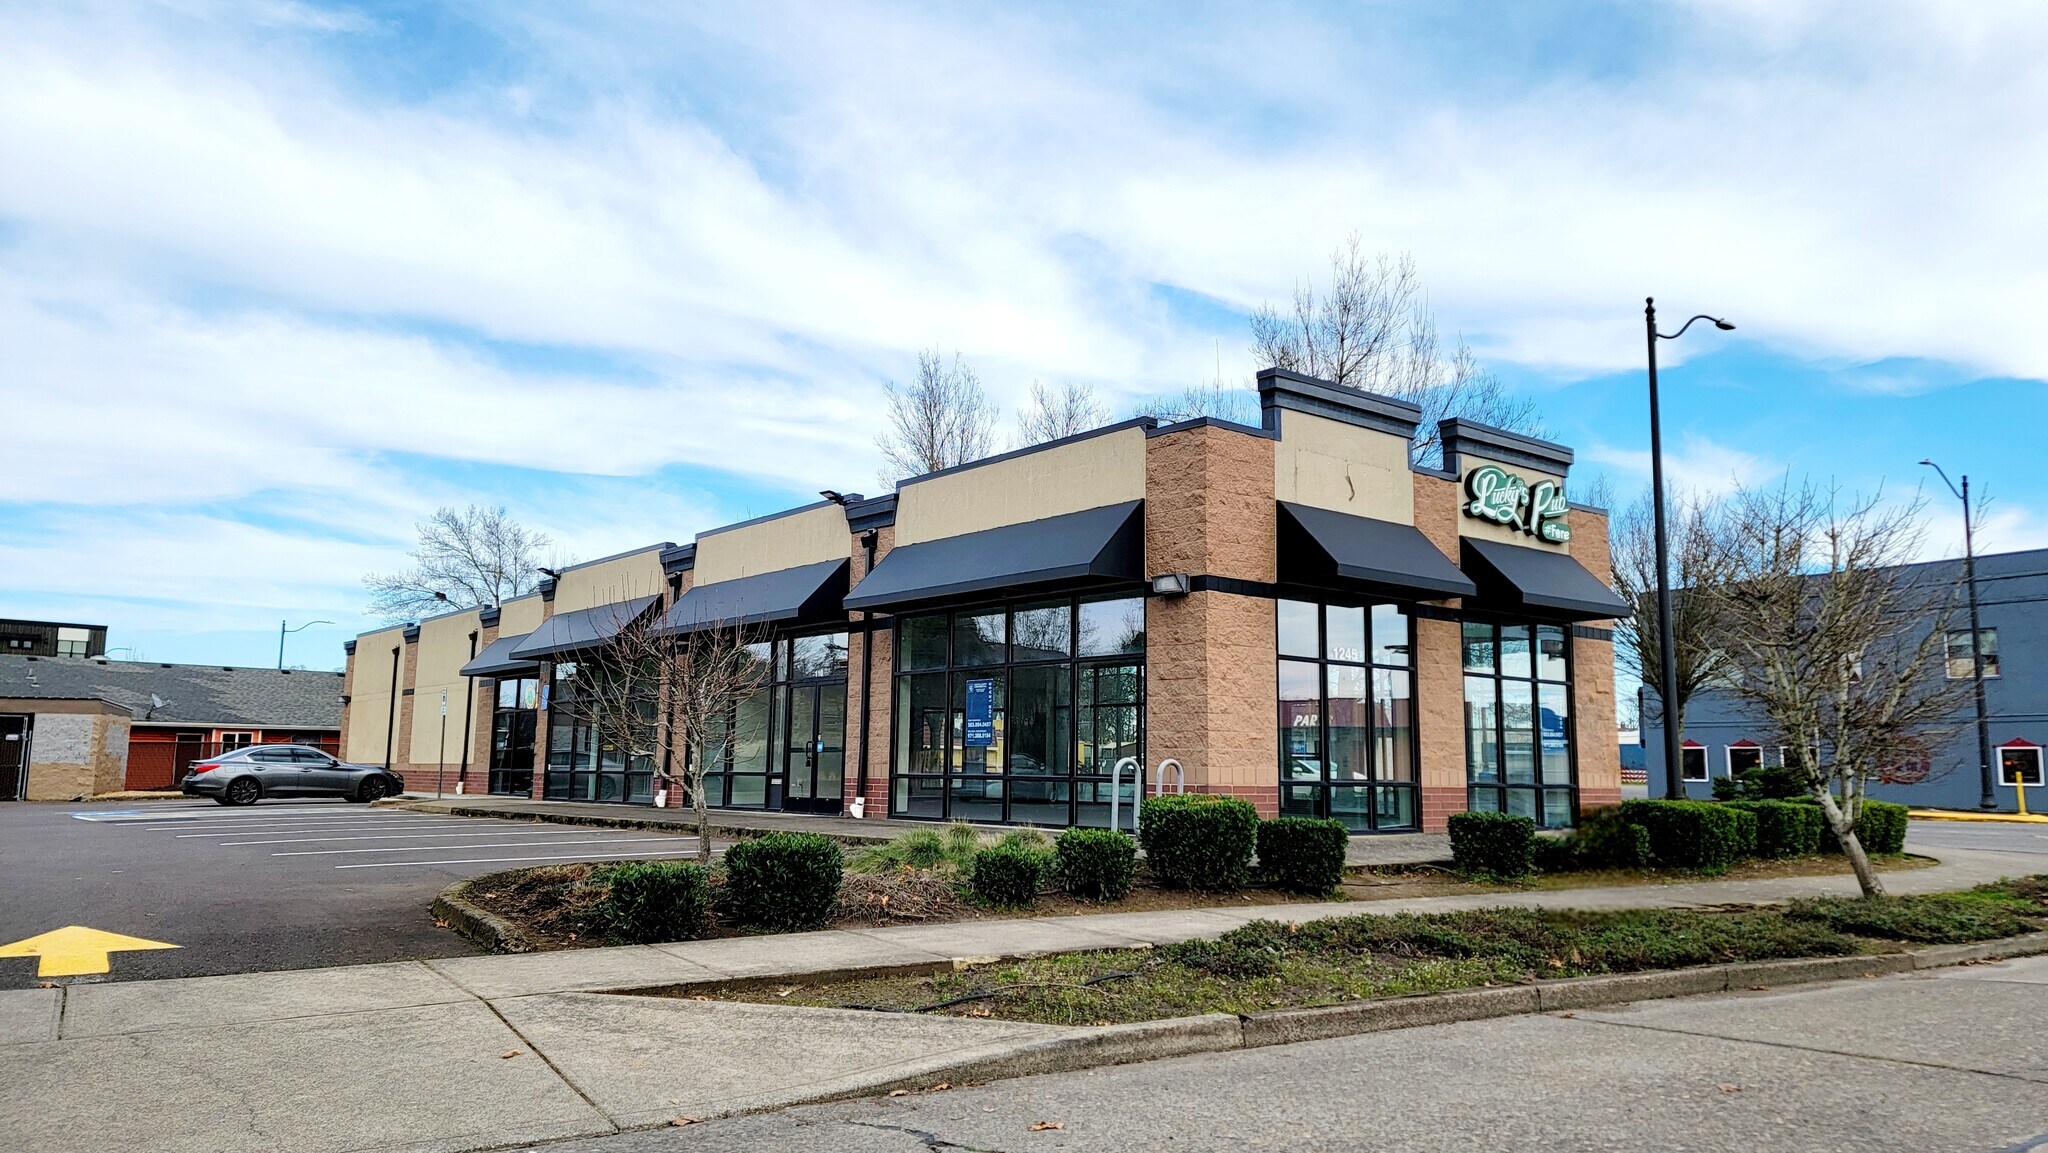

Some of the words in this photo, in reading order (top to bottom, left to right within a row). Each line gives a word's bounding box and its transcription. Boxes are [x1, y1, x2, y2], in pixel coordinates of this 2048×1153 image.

[1471, 468, 1529, 530] Lucky's
[1530, 482, 1569, 534] Pub
[1333, 647, 1358, 659] 1245
